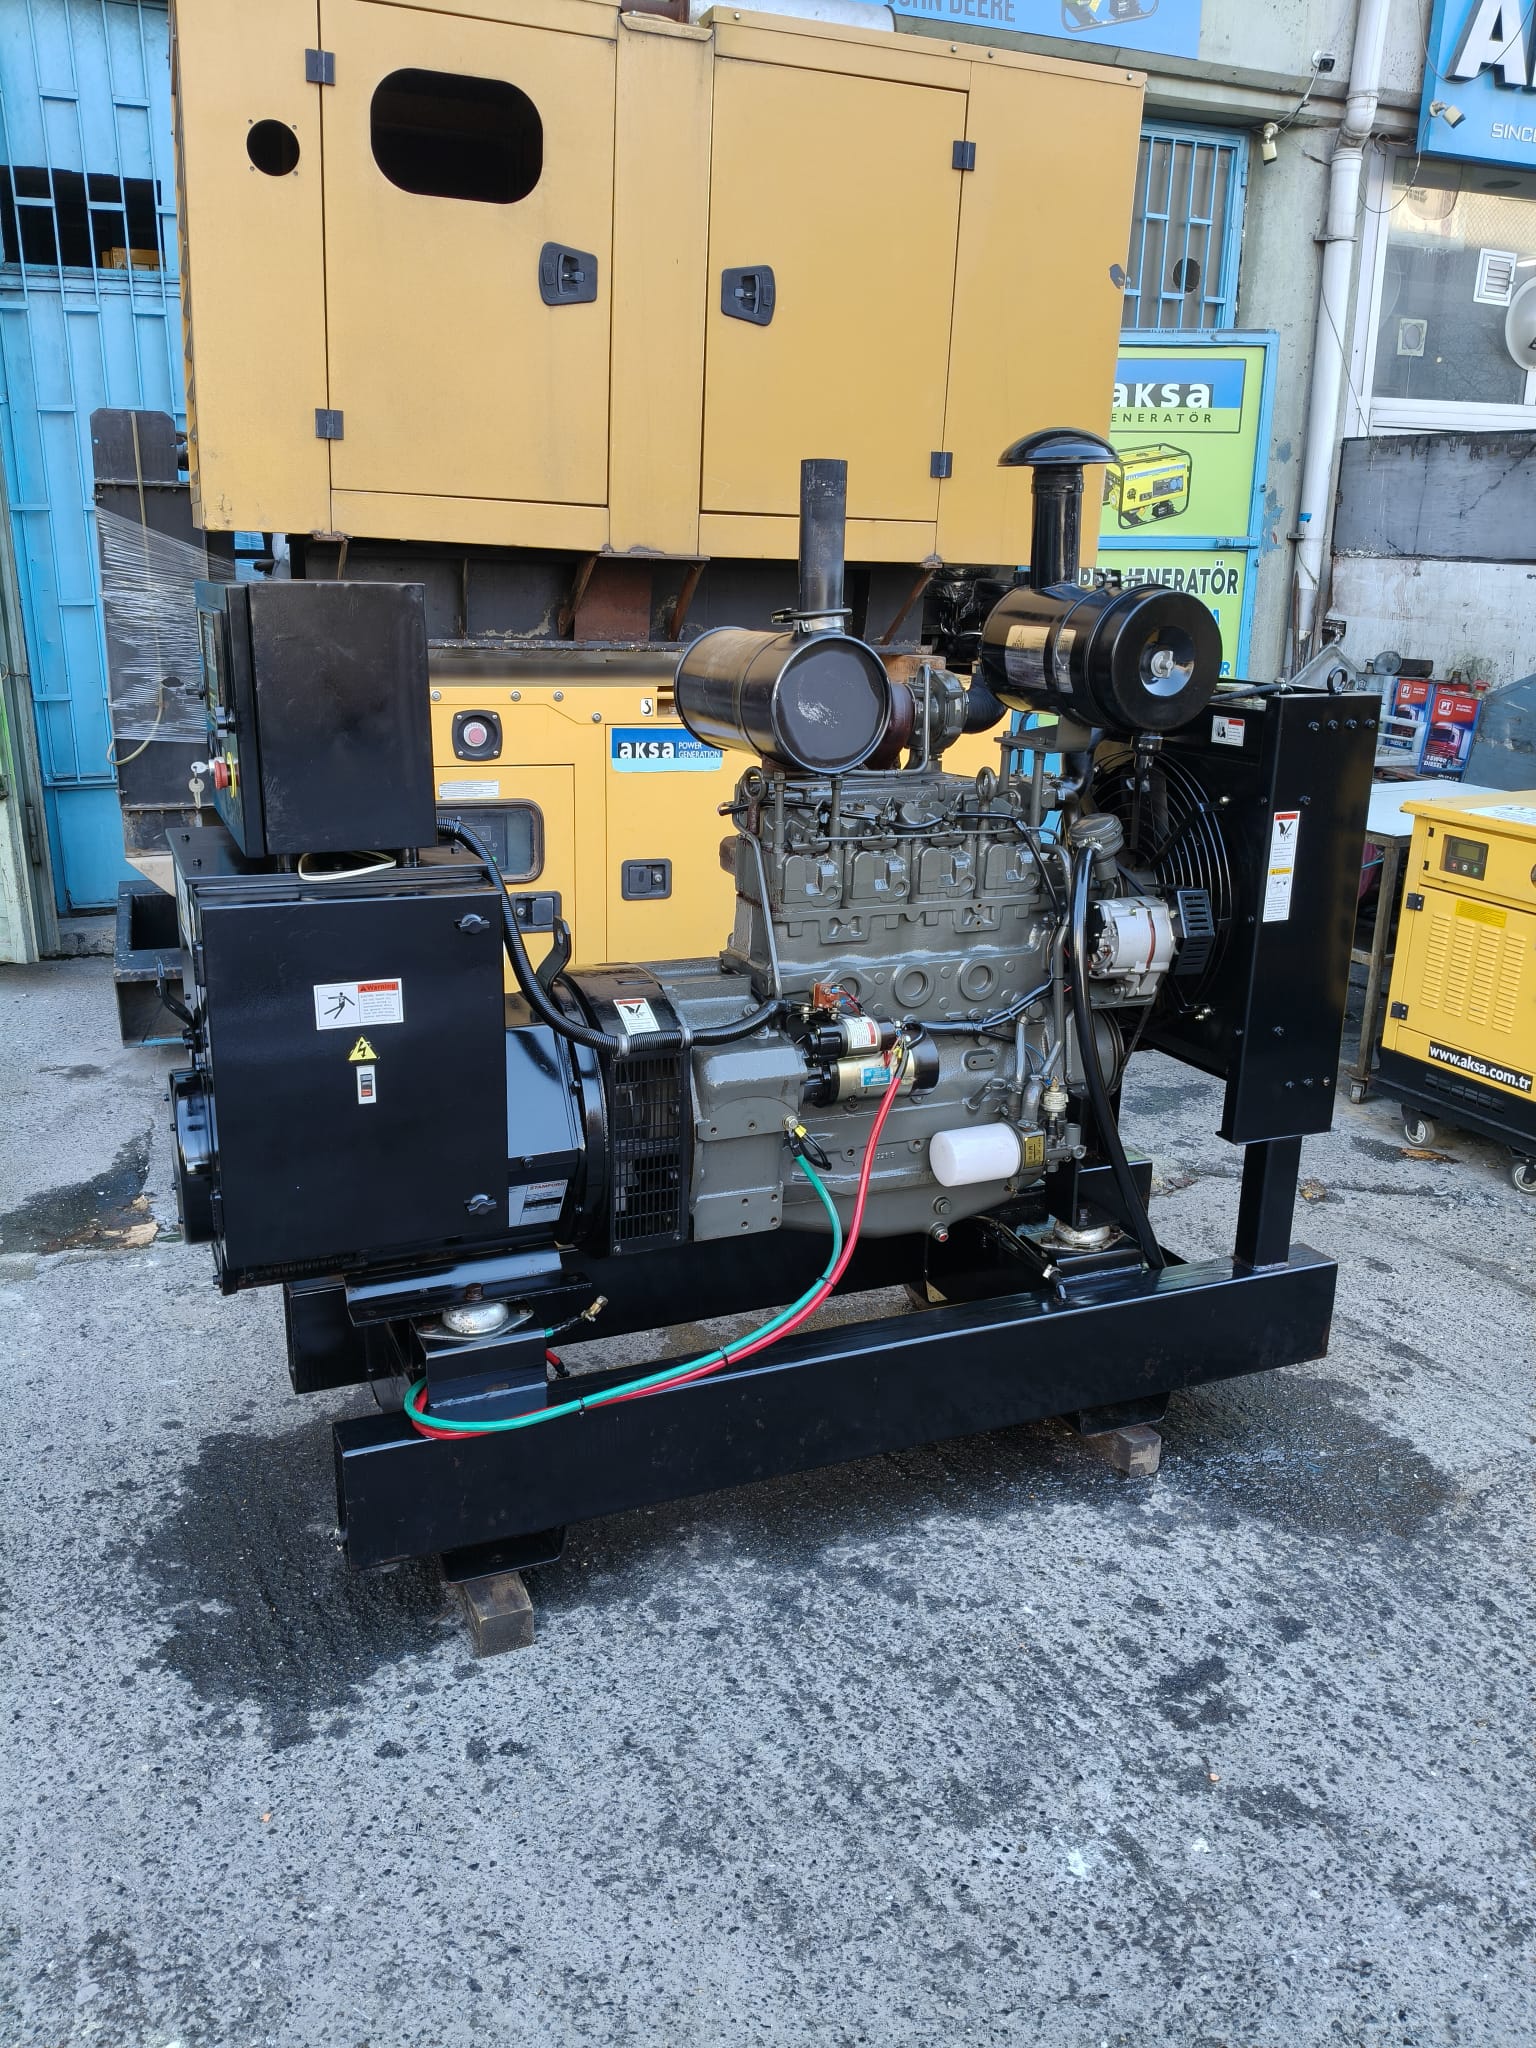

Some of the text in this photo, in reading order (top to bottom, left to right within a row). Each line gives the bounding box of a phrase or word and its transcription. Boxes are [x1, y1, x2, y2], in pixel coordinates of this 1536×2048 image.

[1491, 122, 1536, 143] SINC
[1112, 383, 1210, 408] aksa
[1111, 411, 1212, 423] ENERATÖR
[619, 742, 675, 758] aksa
[678, 741, 703, 749] POWER
[678, 750, 721, 758] GENERATION
[1423, 760, 1443, 769] DIESEL
[1429, 1046, 1532, 1091] www.aksa.com.tr
